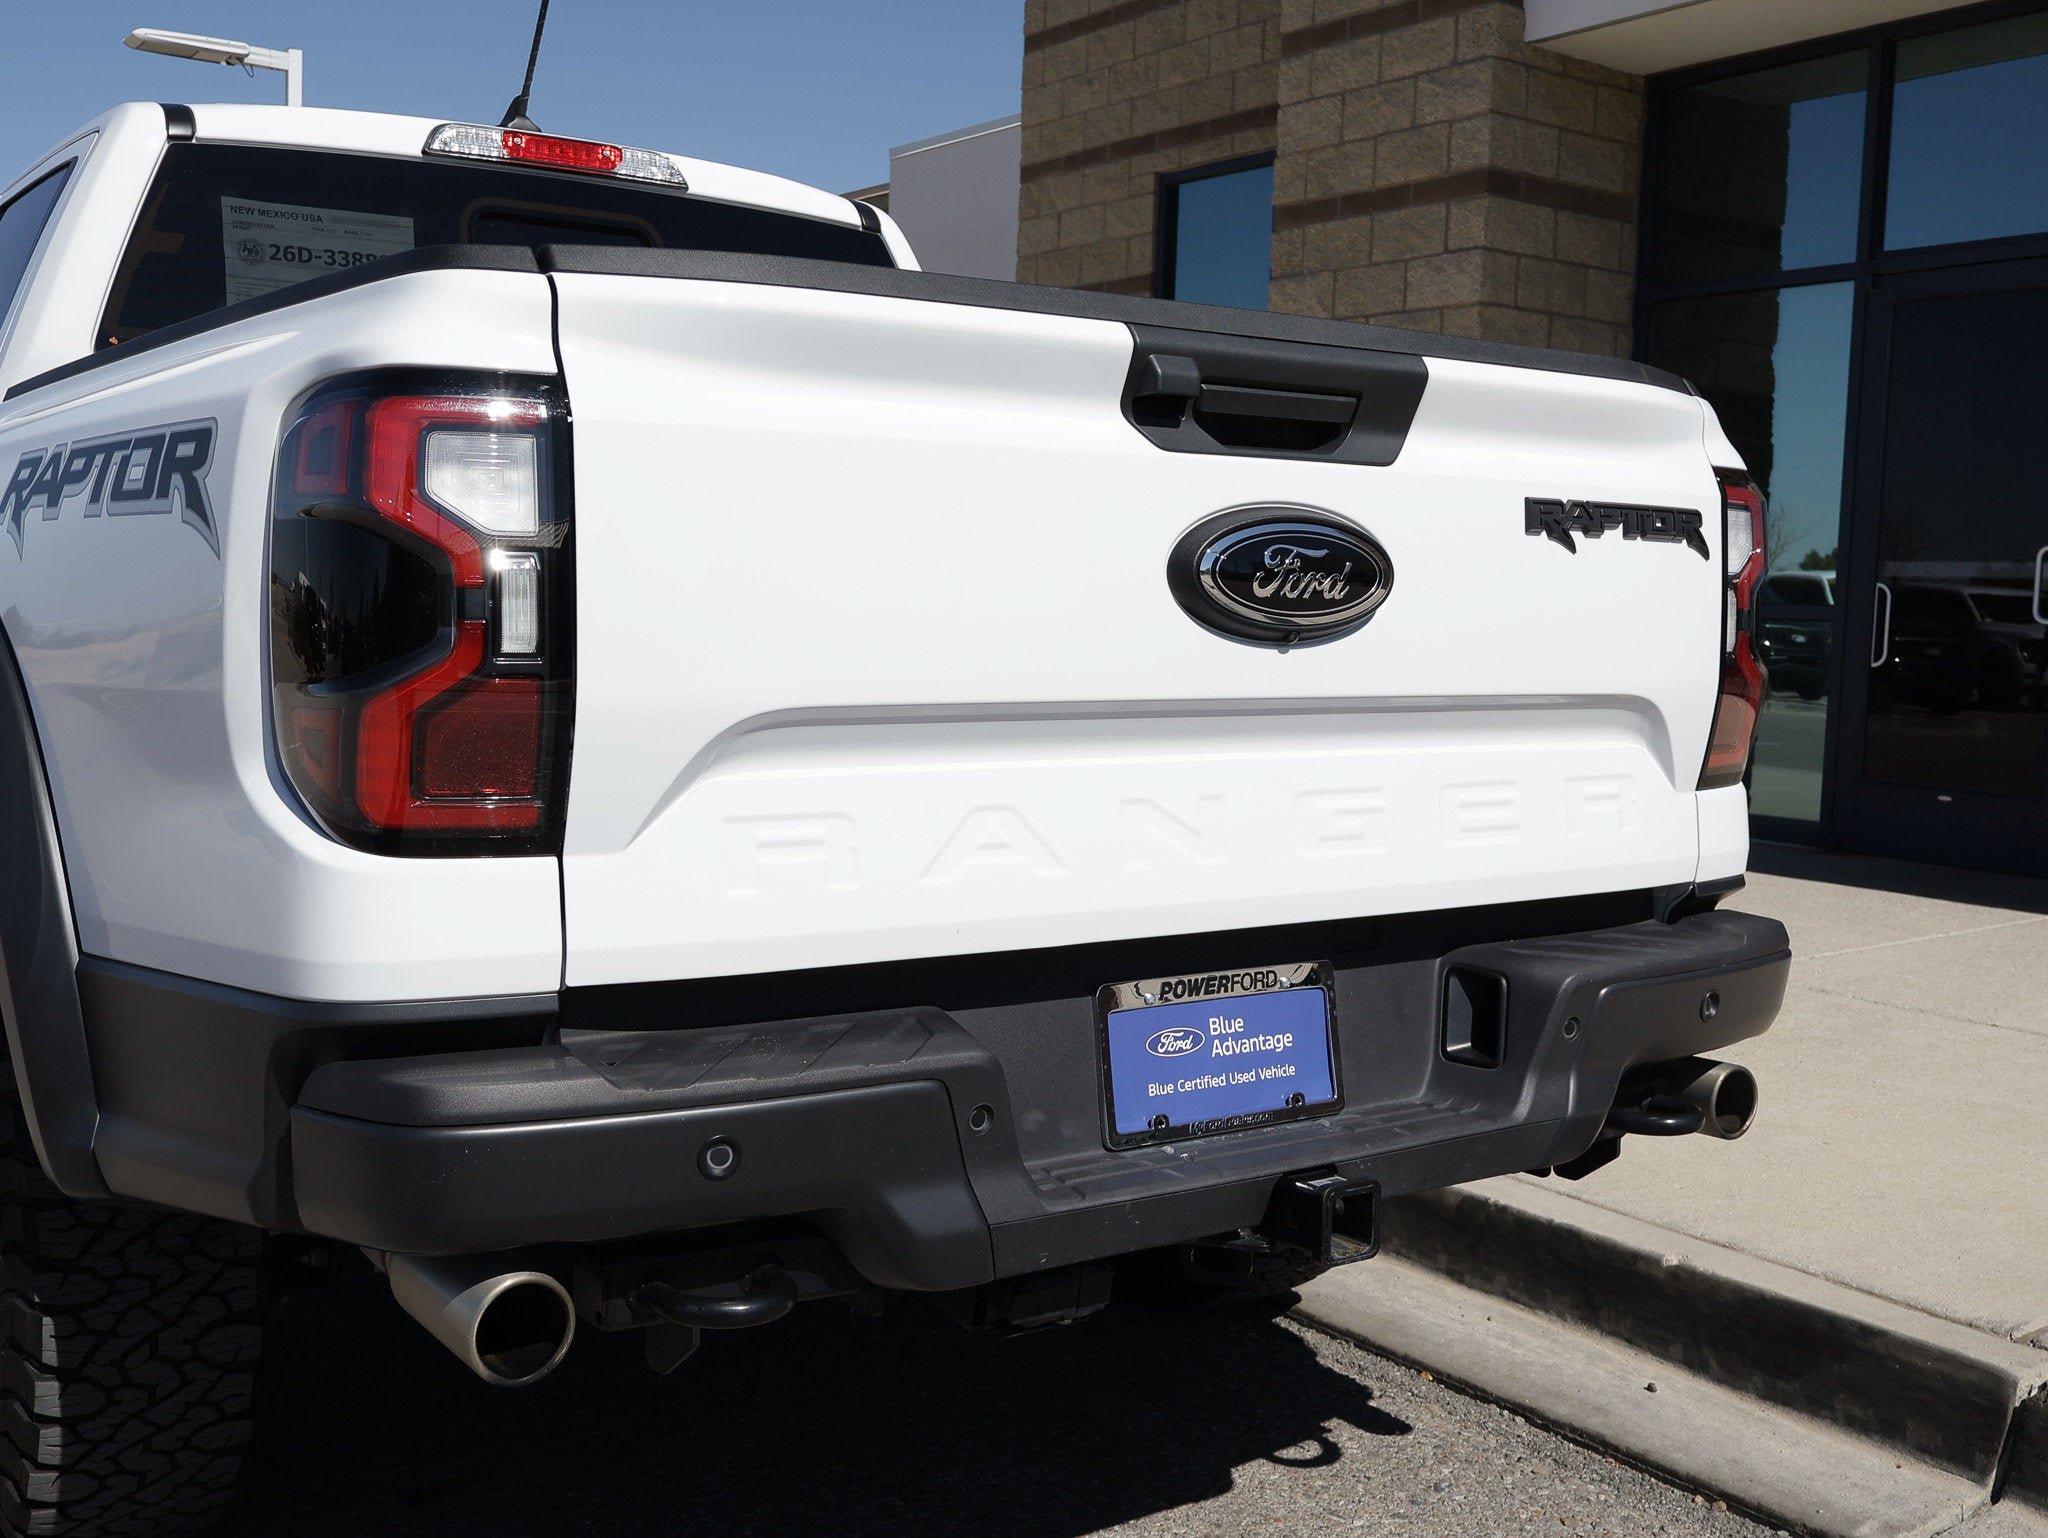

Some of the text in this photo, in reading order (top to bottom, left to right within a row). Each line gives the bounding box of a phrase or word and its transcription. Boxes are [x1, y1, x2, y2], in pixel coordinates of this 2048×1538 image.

[230, 205, 255, 216] NEW
[258, 208, 298, 221] MEXICO
[301, 212, 324, 224] USA
[268, 243, 389, 268] 26D-338
[0, 416, 220, 562] RAPTOR
[1524, 496, 1710, 561] RAPTOR
[1252, 543, 1353, 600] Ford
[721, 772, 1640, 900] RANGER
[1158, 969, 1278, 1000] POWERFORD
[1208, 1016, 1244, 1036] Blue
[1157, 1031, 1194, 1053] Ford
[1211, 1032, 1293, 1058] Advantage
[1148, 1063, 1296, 1096] Blue Certified Used Vehicle
